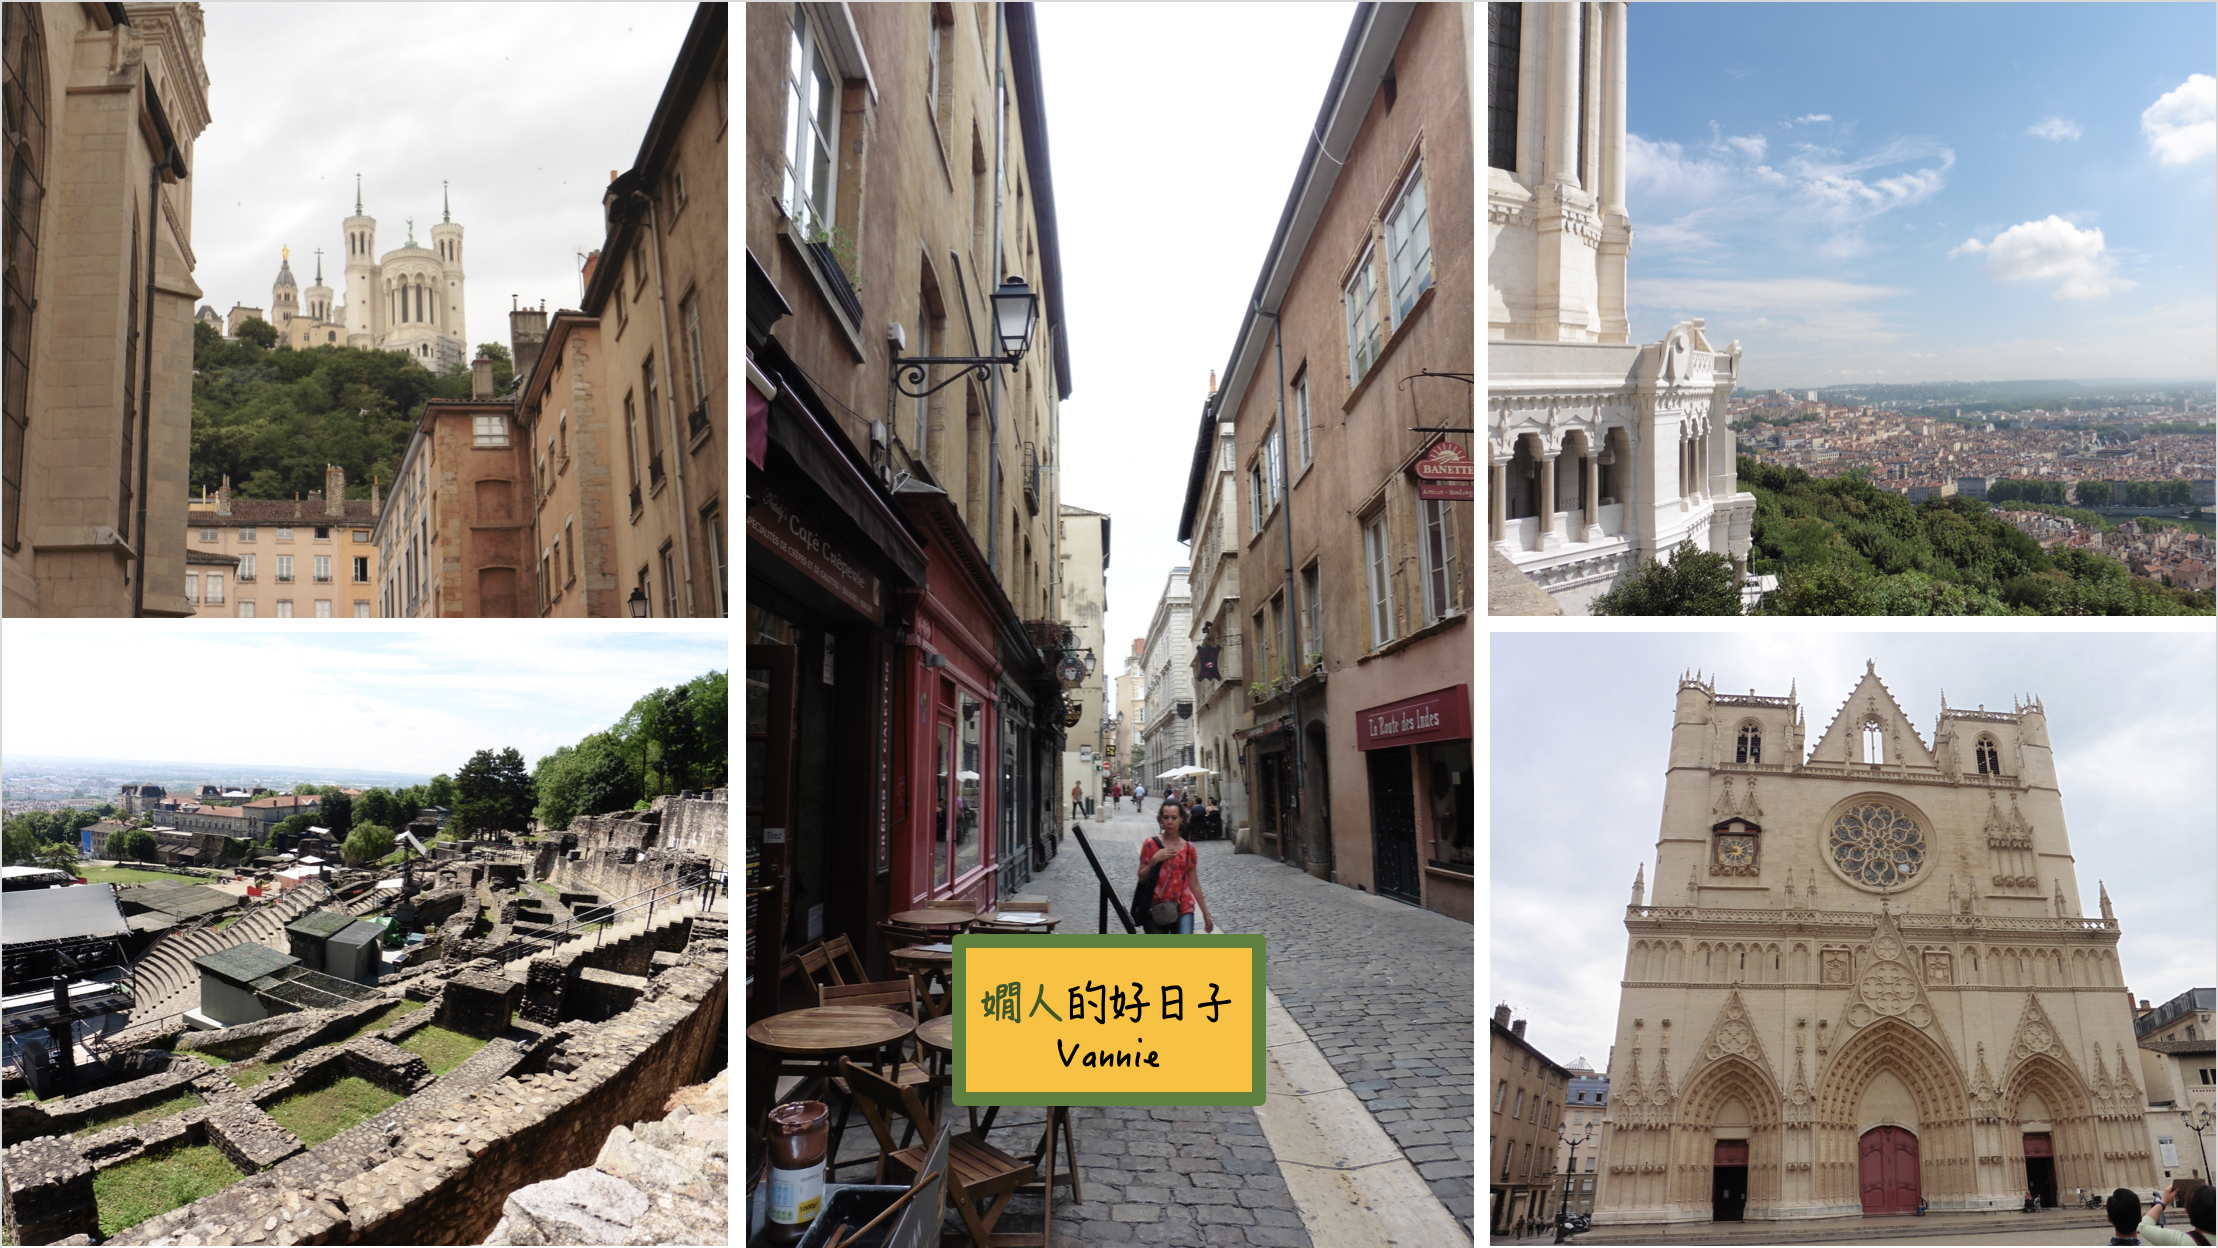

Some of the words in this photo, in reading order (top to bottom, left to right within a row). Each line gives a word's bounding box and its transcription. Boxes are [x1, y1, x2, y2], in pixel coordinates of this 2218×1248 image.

[1422, 464, 1474, 475] BANETTE
[779, 540, 788, 552] DE
[789, 514, 820, 552] Café
[823, 542, 866, 589] Crêperie
[1368, 719, 1378, 737] La
[1378, 713, 1399, 736] Route
[1401, 711, 1415, 732] des
[1416, 705, 1440, 729] Indes
[882, 760, 887, 782] ET
